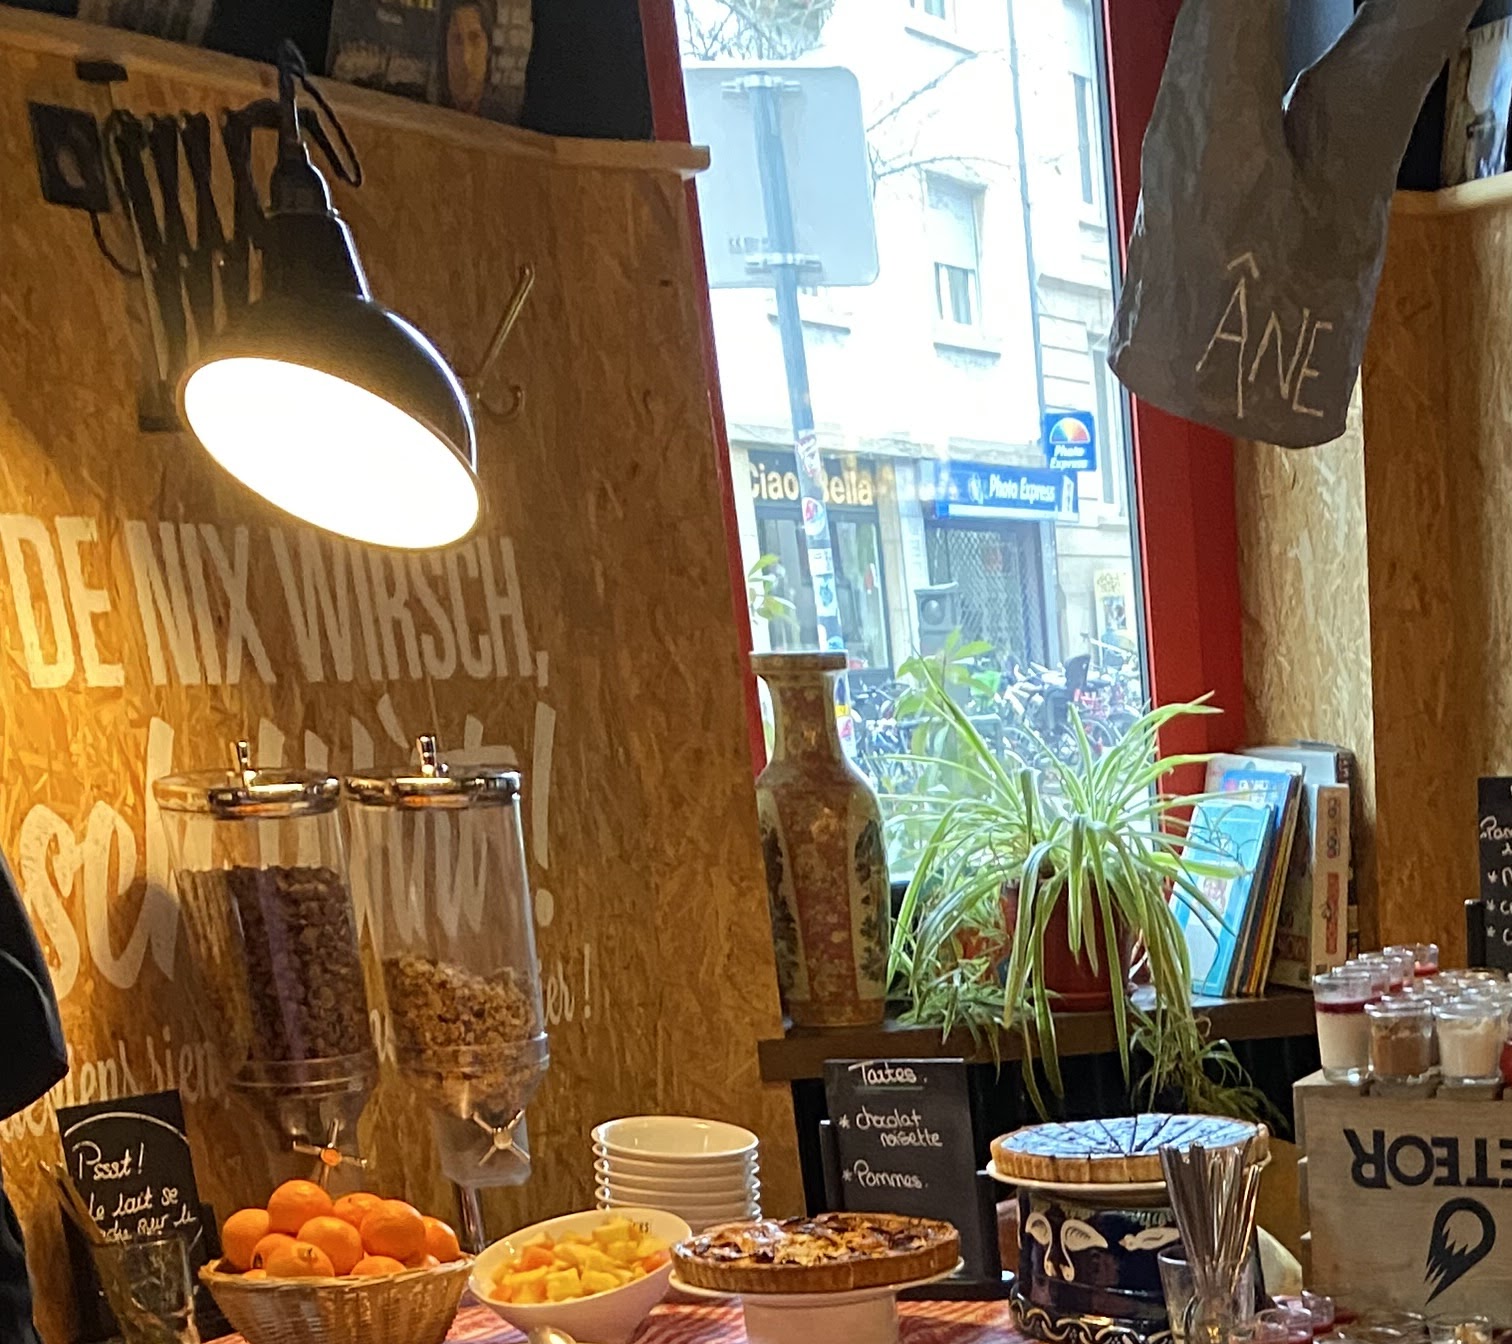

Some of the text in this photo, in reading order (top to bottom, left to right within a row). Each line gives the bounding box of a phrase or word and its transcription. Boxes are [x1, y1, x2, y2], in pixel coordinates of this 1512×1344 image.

[1196, 251, 1334, 418] ÂNE
[749, 463, 799, 500] Ciao
[988, 474, 1056, 504] Photo Express
[124, 519, 277, 686] NIX
